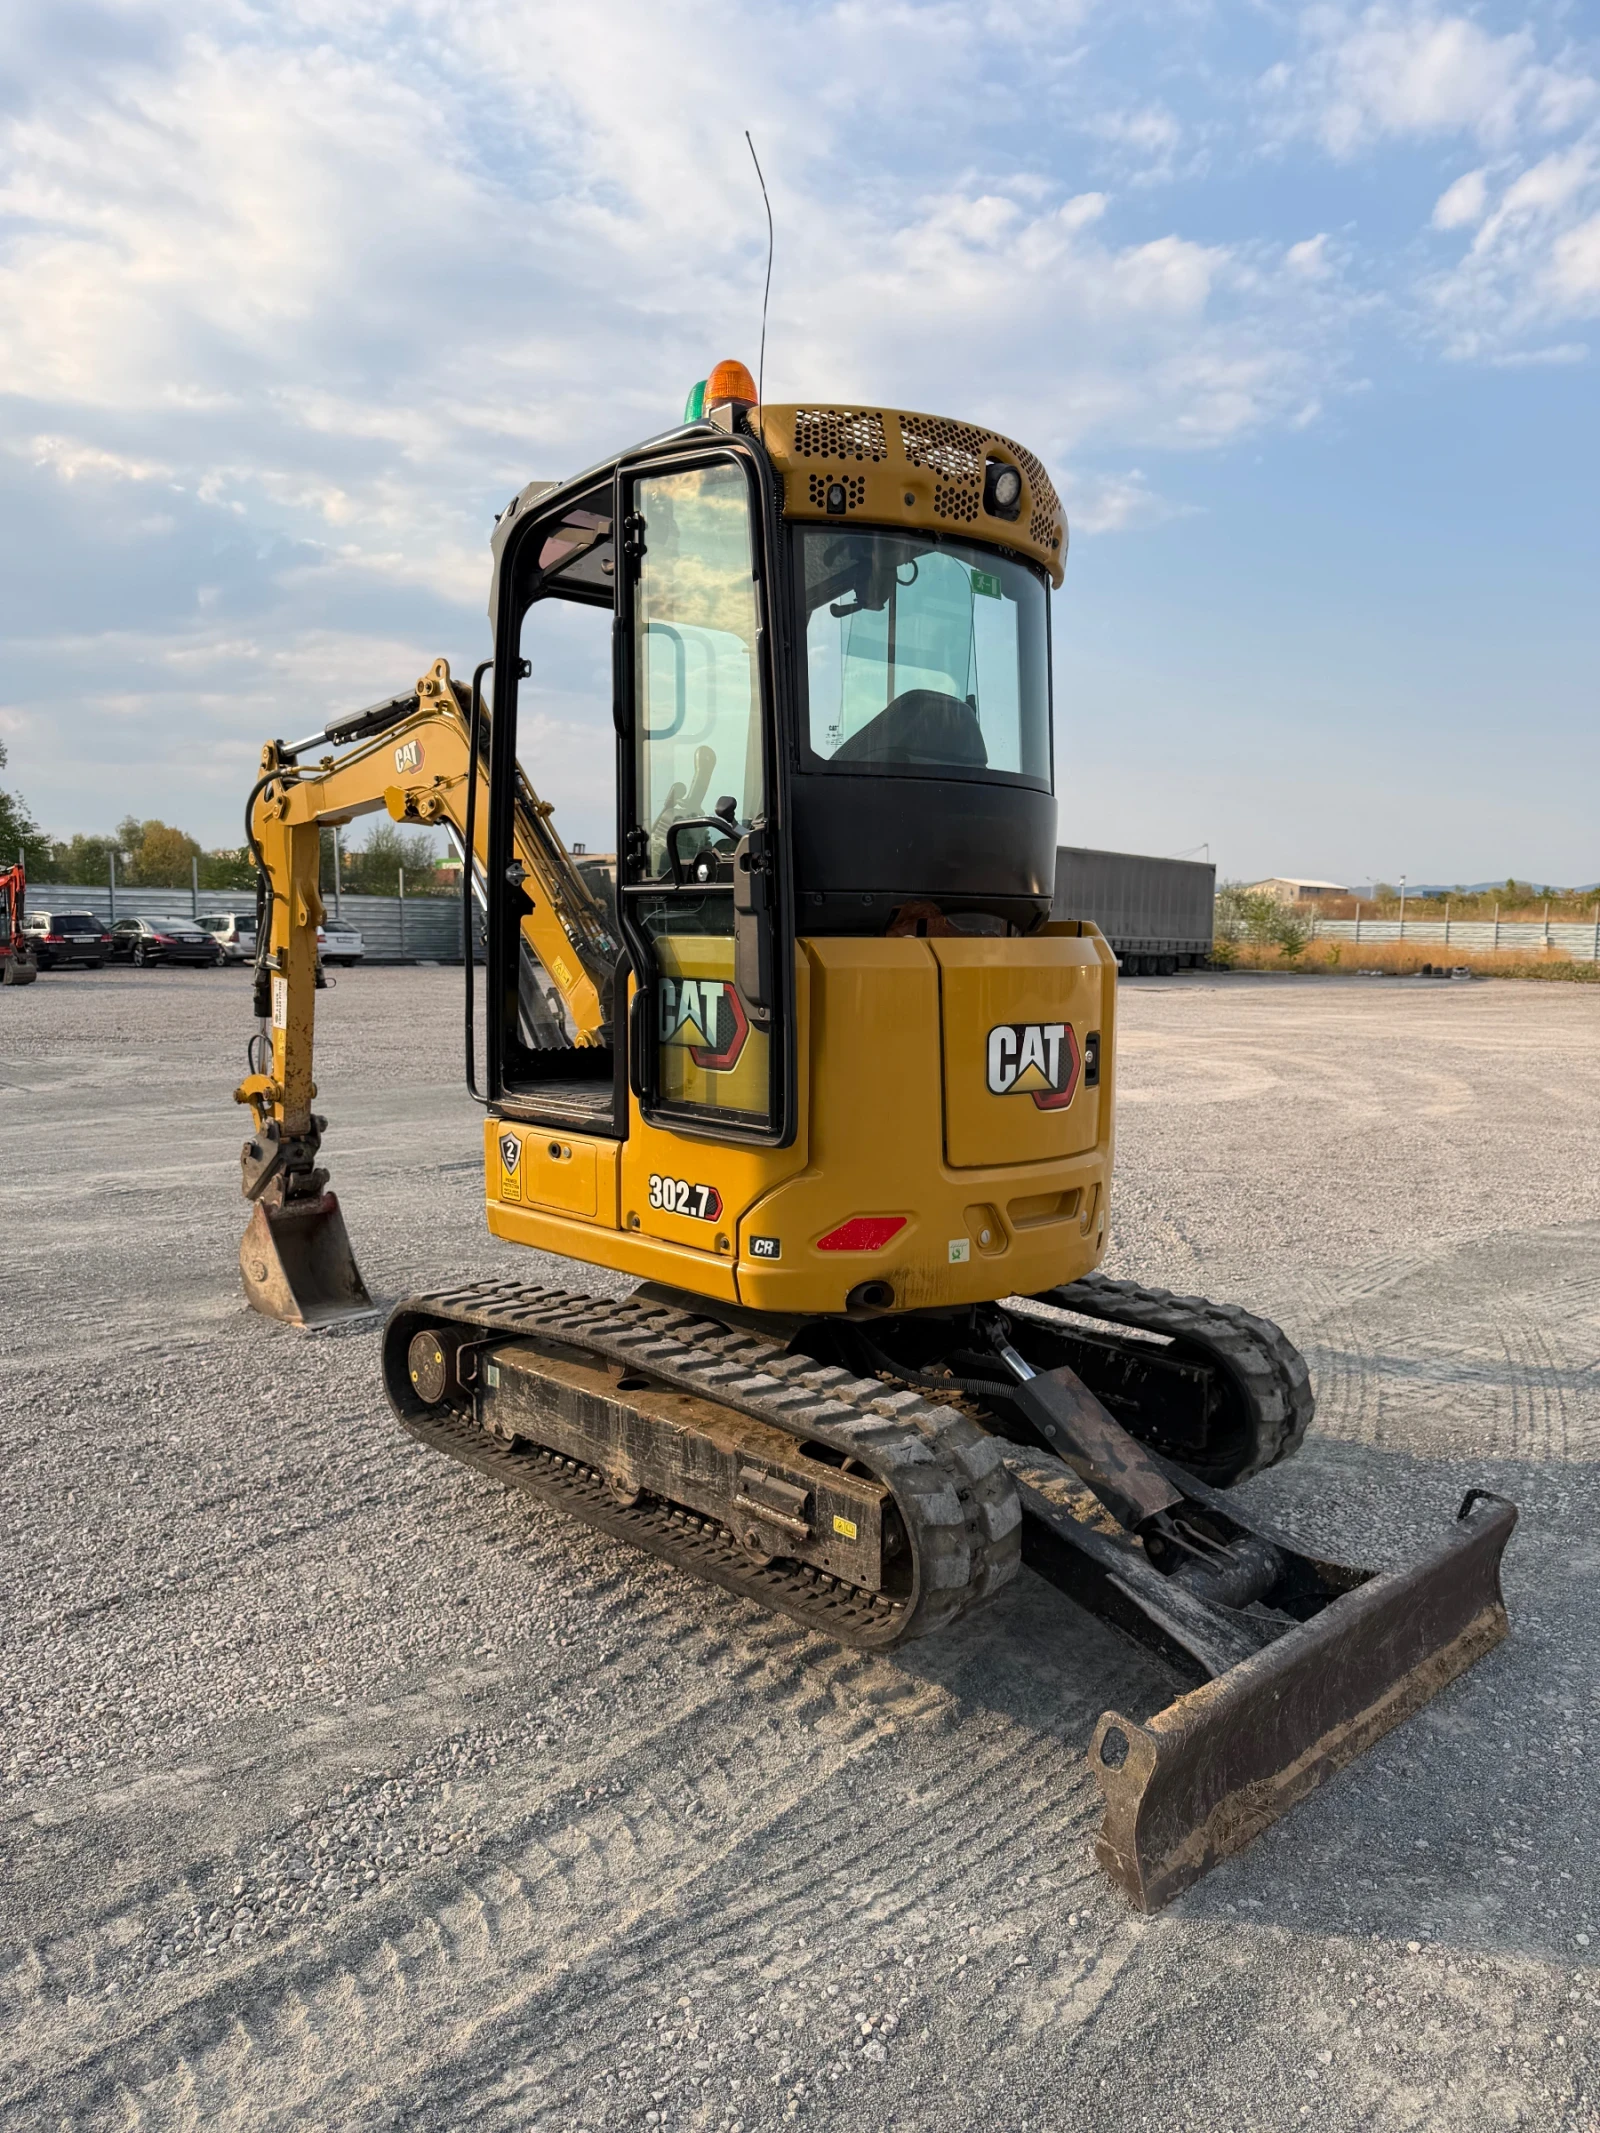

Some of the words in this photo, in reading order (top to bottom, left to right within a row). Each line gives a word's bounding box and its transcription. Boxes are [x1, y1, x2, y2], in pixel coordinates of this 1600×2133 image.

[395, 740, 418, 773] CAT
[659, 978, 724, 1048] CAT
[988, 1024, 1065, 1093] CAT
[506, 1142, 514, 1158] 2
[649, 1174, 710, 1219] 302.7
[754, 1239, 774, 1255] CR
